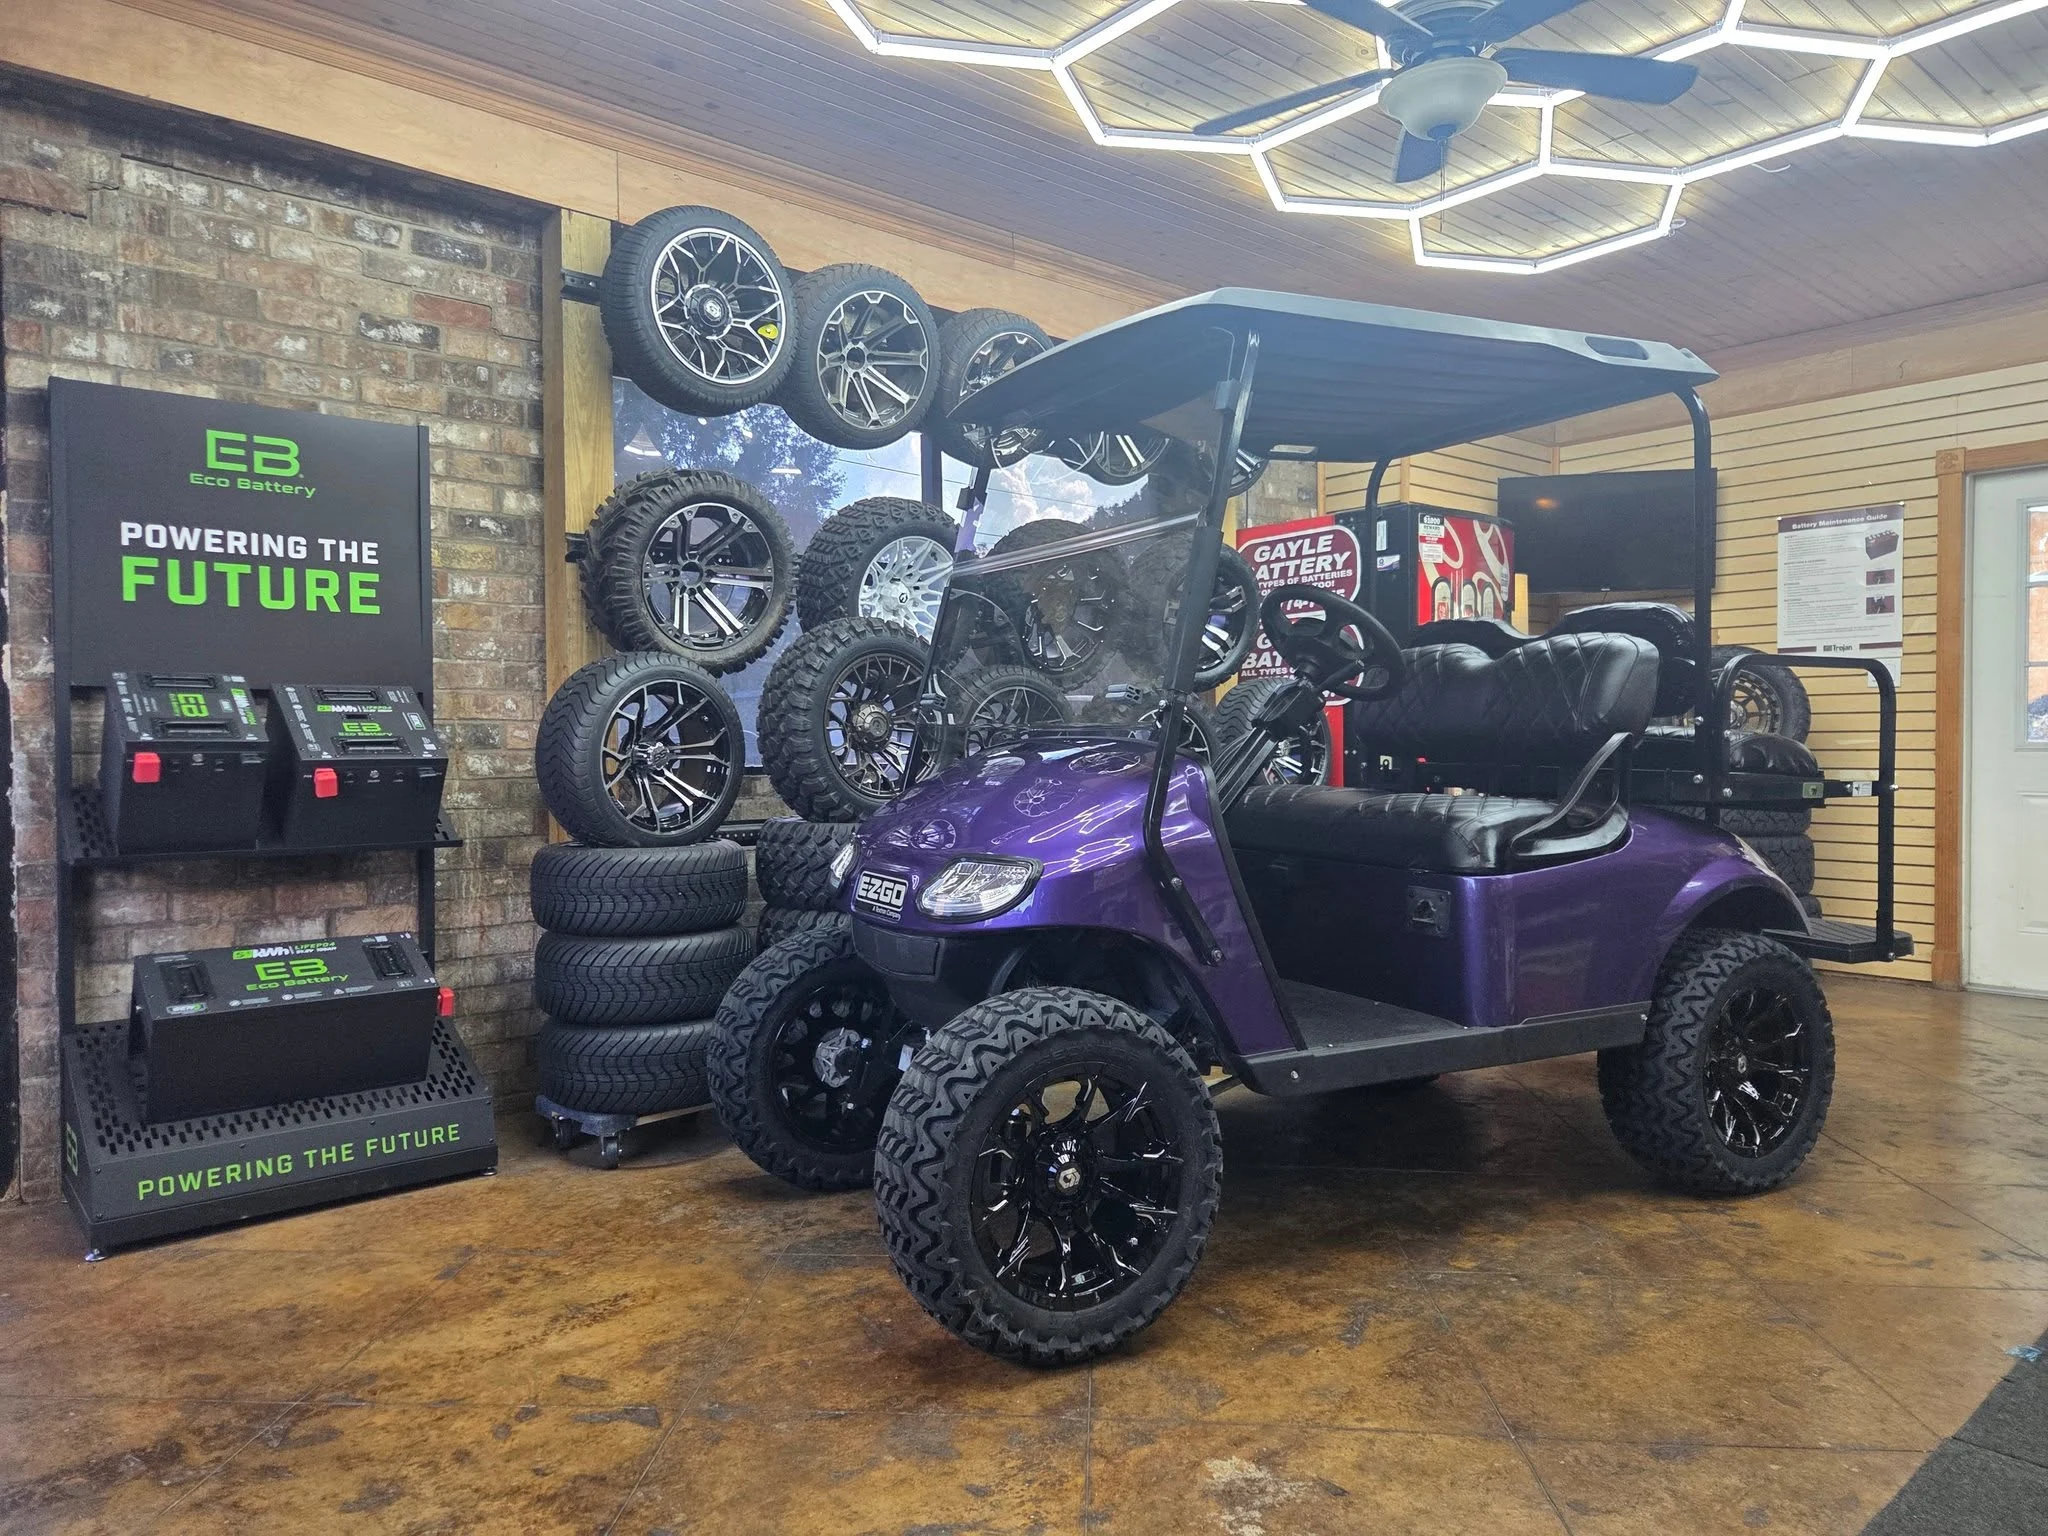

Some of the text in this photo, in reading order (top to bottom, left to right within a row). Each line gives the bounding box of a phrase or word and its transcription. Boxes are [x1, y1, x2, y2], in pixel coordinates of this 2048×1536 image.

[206, 429, 301, 477] EB
[189, 473, 316, 499] Eco Battery
[1792, 513, 1888, 530] Battery Maintenance Guide
[120, 521, 379, 565] POWERING THE
[1254, 534, 1334, 562] GAYLE
[1252, 551, 1352, 580] ATTERY
[1287, 577, 1299, 585] OF
[1301, 569, 1353, 583] BATTERIES
[121, 555, 381, 615] FUTURE
[1832, 643, 1853, 653] Trojan
[1241, 669, 1257, 677] ALL
[1260, 667, 1288, 676] TYPES
[246, 974, 348, 991] Eco Battery
[138, 1123, 460, 1201] POWERING THE FUTURE
